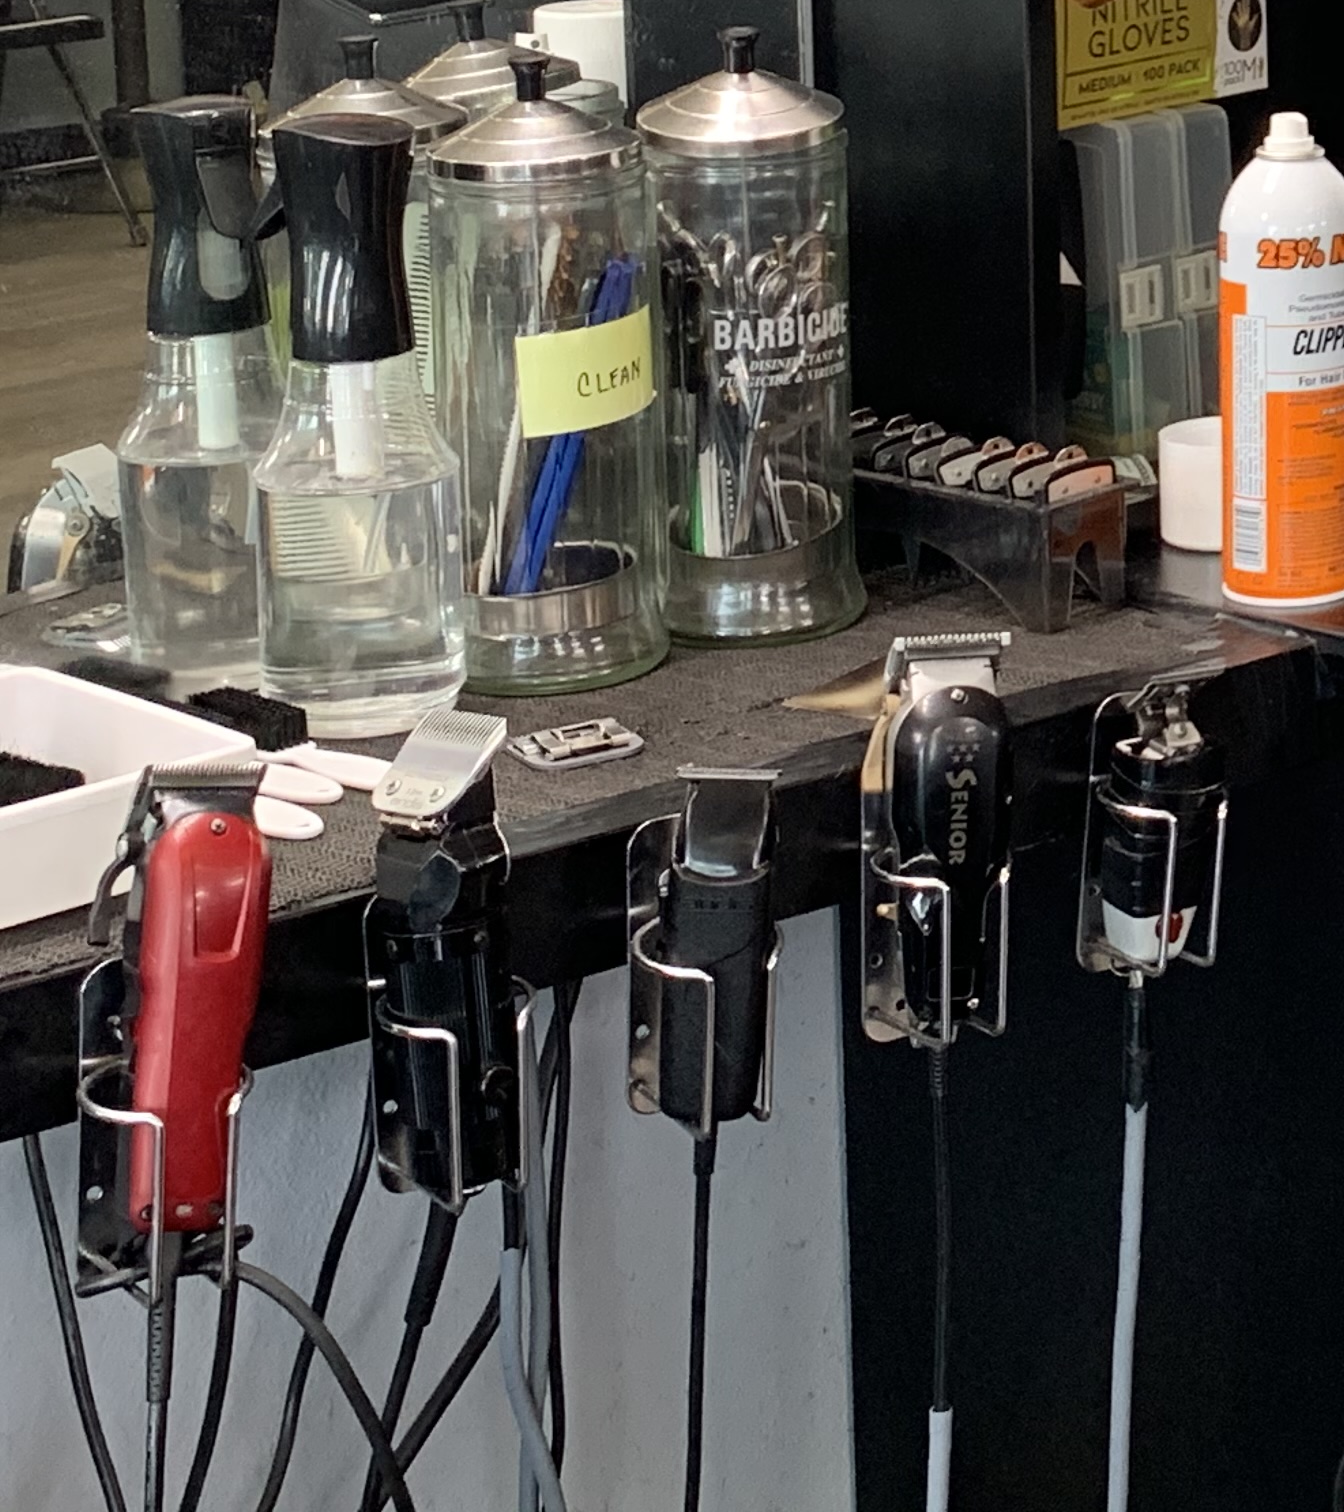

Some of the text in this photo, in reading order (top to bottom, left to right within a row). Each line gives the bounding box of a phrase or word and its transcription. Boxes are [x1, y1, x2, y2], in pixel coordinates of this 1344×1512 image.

[1088, 16, 1190, 58] GLOVES
[1078, 59, 1201, 95] MEDIUM 100 PACK
[1257, 237, 1325, 269] 25%
[714, 302, 848, 350] BARBICIDE
[577, 356, 641, 397] CLEAN
[1299, 374, 1317, 387] For
[1320, 371, 1341, 385] Hair
[945, 769, 977, 866] SENIOR
